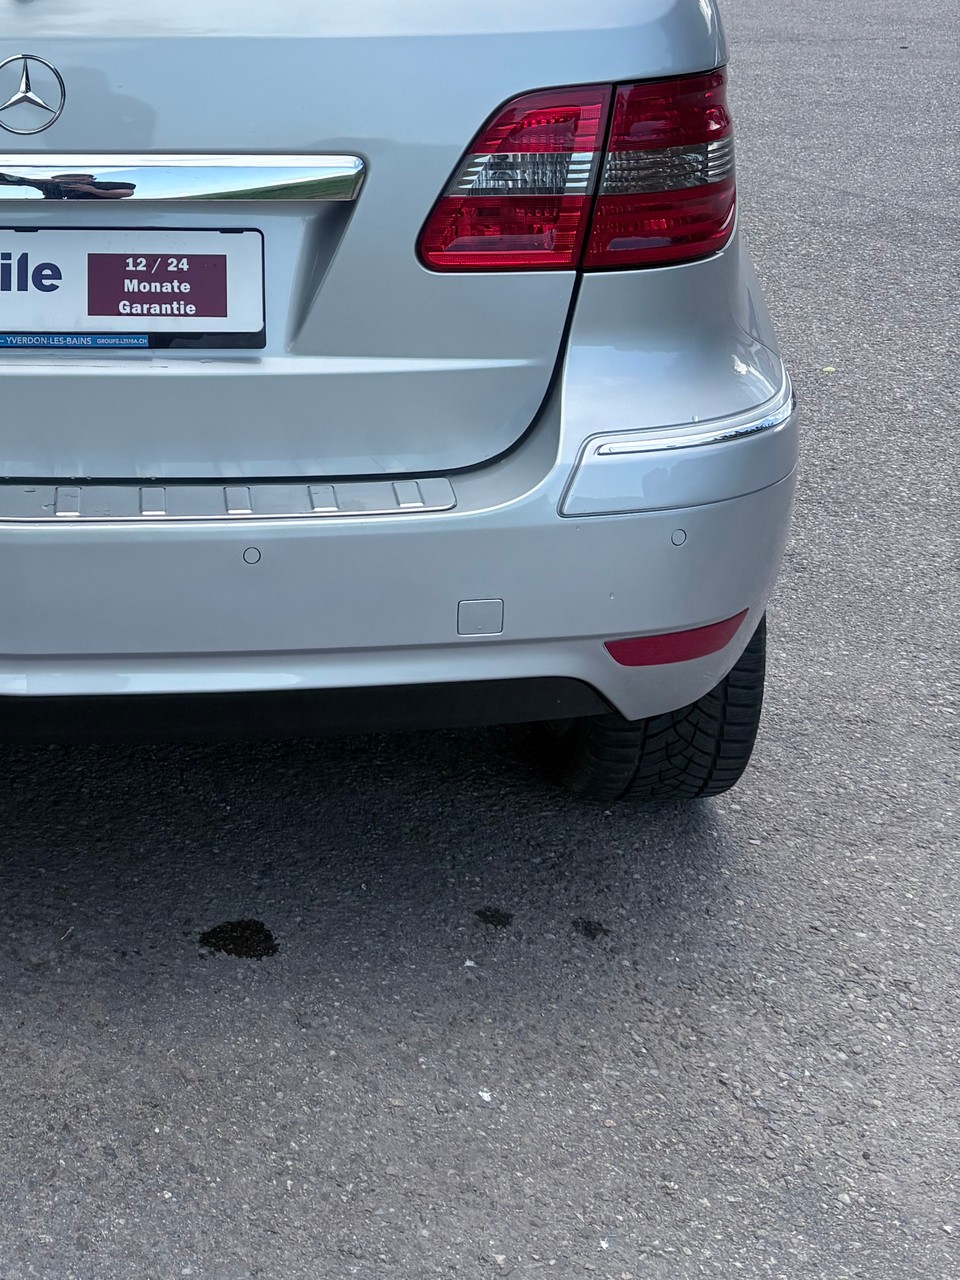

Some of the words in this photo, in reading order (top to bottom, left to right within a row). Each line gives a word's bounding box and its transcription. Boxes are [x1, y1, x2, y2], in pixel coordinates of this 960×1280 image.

[125, 257, 147, 271] 12
[151, 257, 161, 274] /
[167, 258, 189, 271] 24
[124, 279, 191, 293] Monate
[118, 300, 196, 315] Garantie
[6, 336, 92, 345] YVERDON-LES-BAINS
